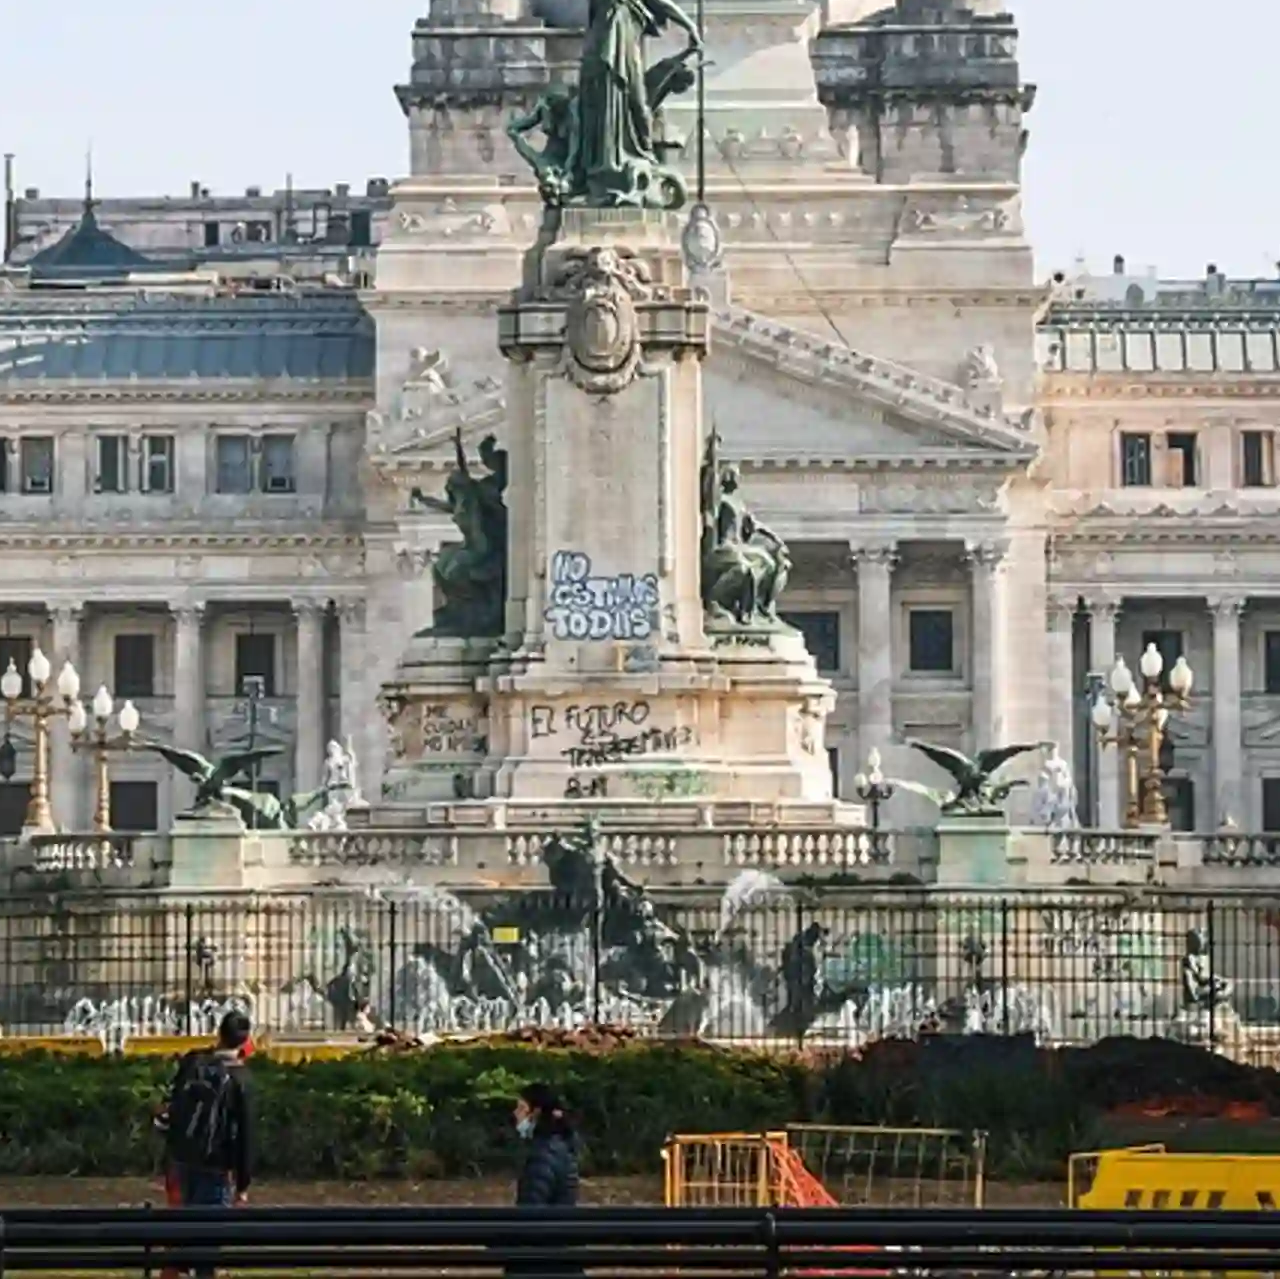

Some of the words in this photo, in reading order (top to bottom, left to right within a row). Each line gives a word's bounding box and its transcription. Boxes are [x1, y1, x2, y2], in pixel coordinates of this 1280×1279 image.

[552, 549, 591, 584] NO
[531, 705, 557, 738] EL
[564, 700, 650, 730] FUTURO
